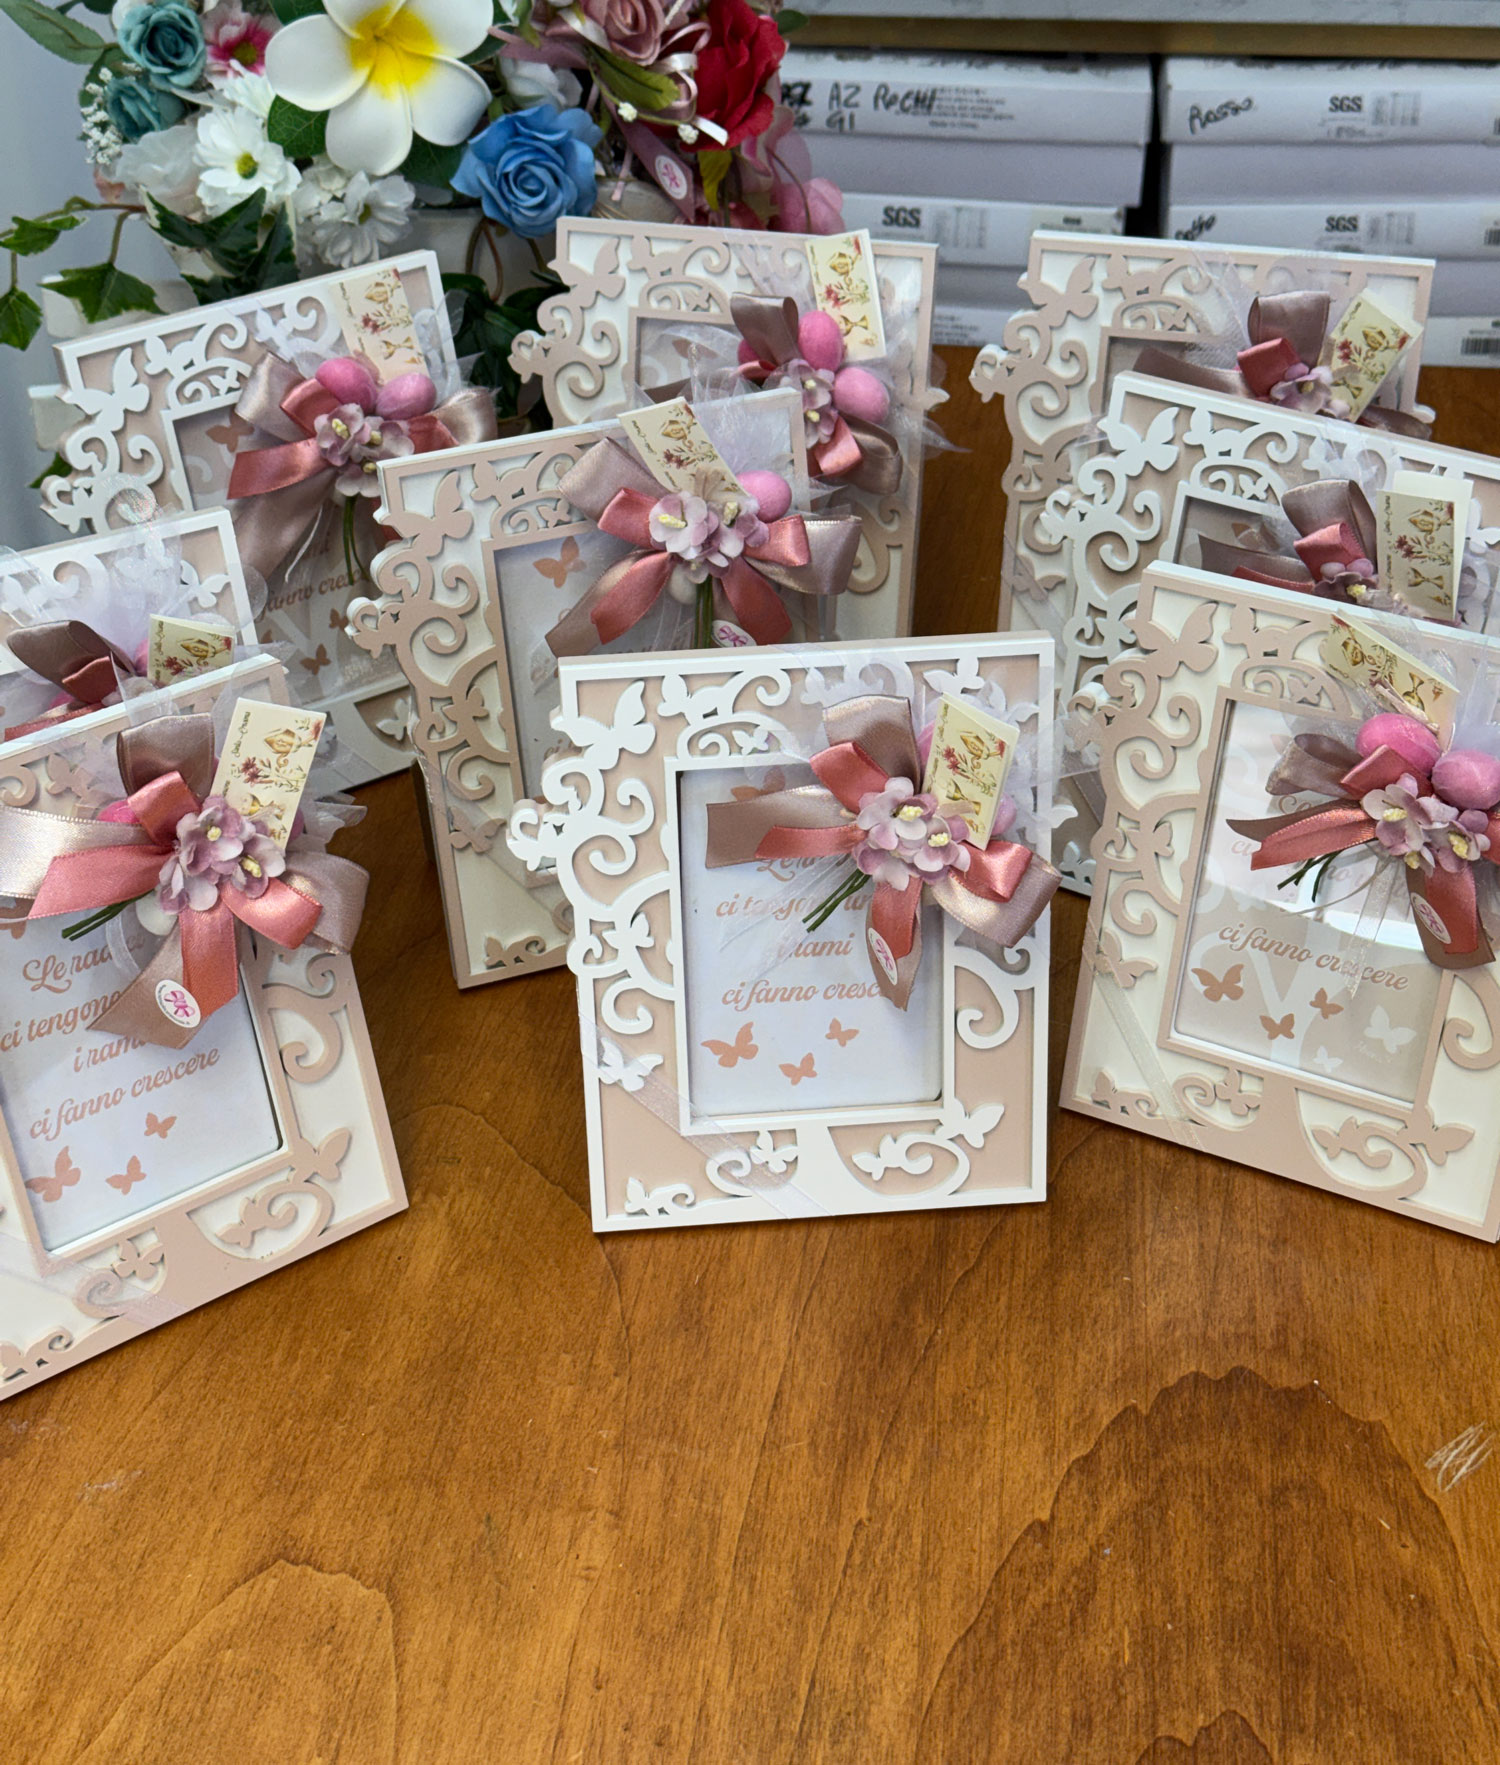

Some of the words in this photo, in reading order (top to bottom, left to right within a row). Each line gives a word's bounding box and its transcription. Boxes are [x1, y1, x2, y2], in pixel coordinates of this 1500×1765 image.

[1327, 95, 1363, 113] SGS
[882, 205, 922, 228] SGS
[1324, 215, 1359, 233] SGS
[716, 893, 739, 918] ci
[1218, 922, 1245, 944] ci
[1229, 926, 1314, 963] fanno
[22, 954, 73, 994] Le
[721, 981, 745, 1005] ci
[734, 979, 819, 1012] fanno
[822, 982, 885, 1001] cresc
[0, 1020, 23, 1052] ci
[73, 1046, 85, 1073] i
[87, 1036, 147, 1069] ram
[29, 1107, 53, 1140] ci
[45, 1097, 126, 1142] fanno
[130, 1048, 221, 1099] crescere
